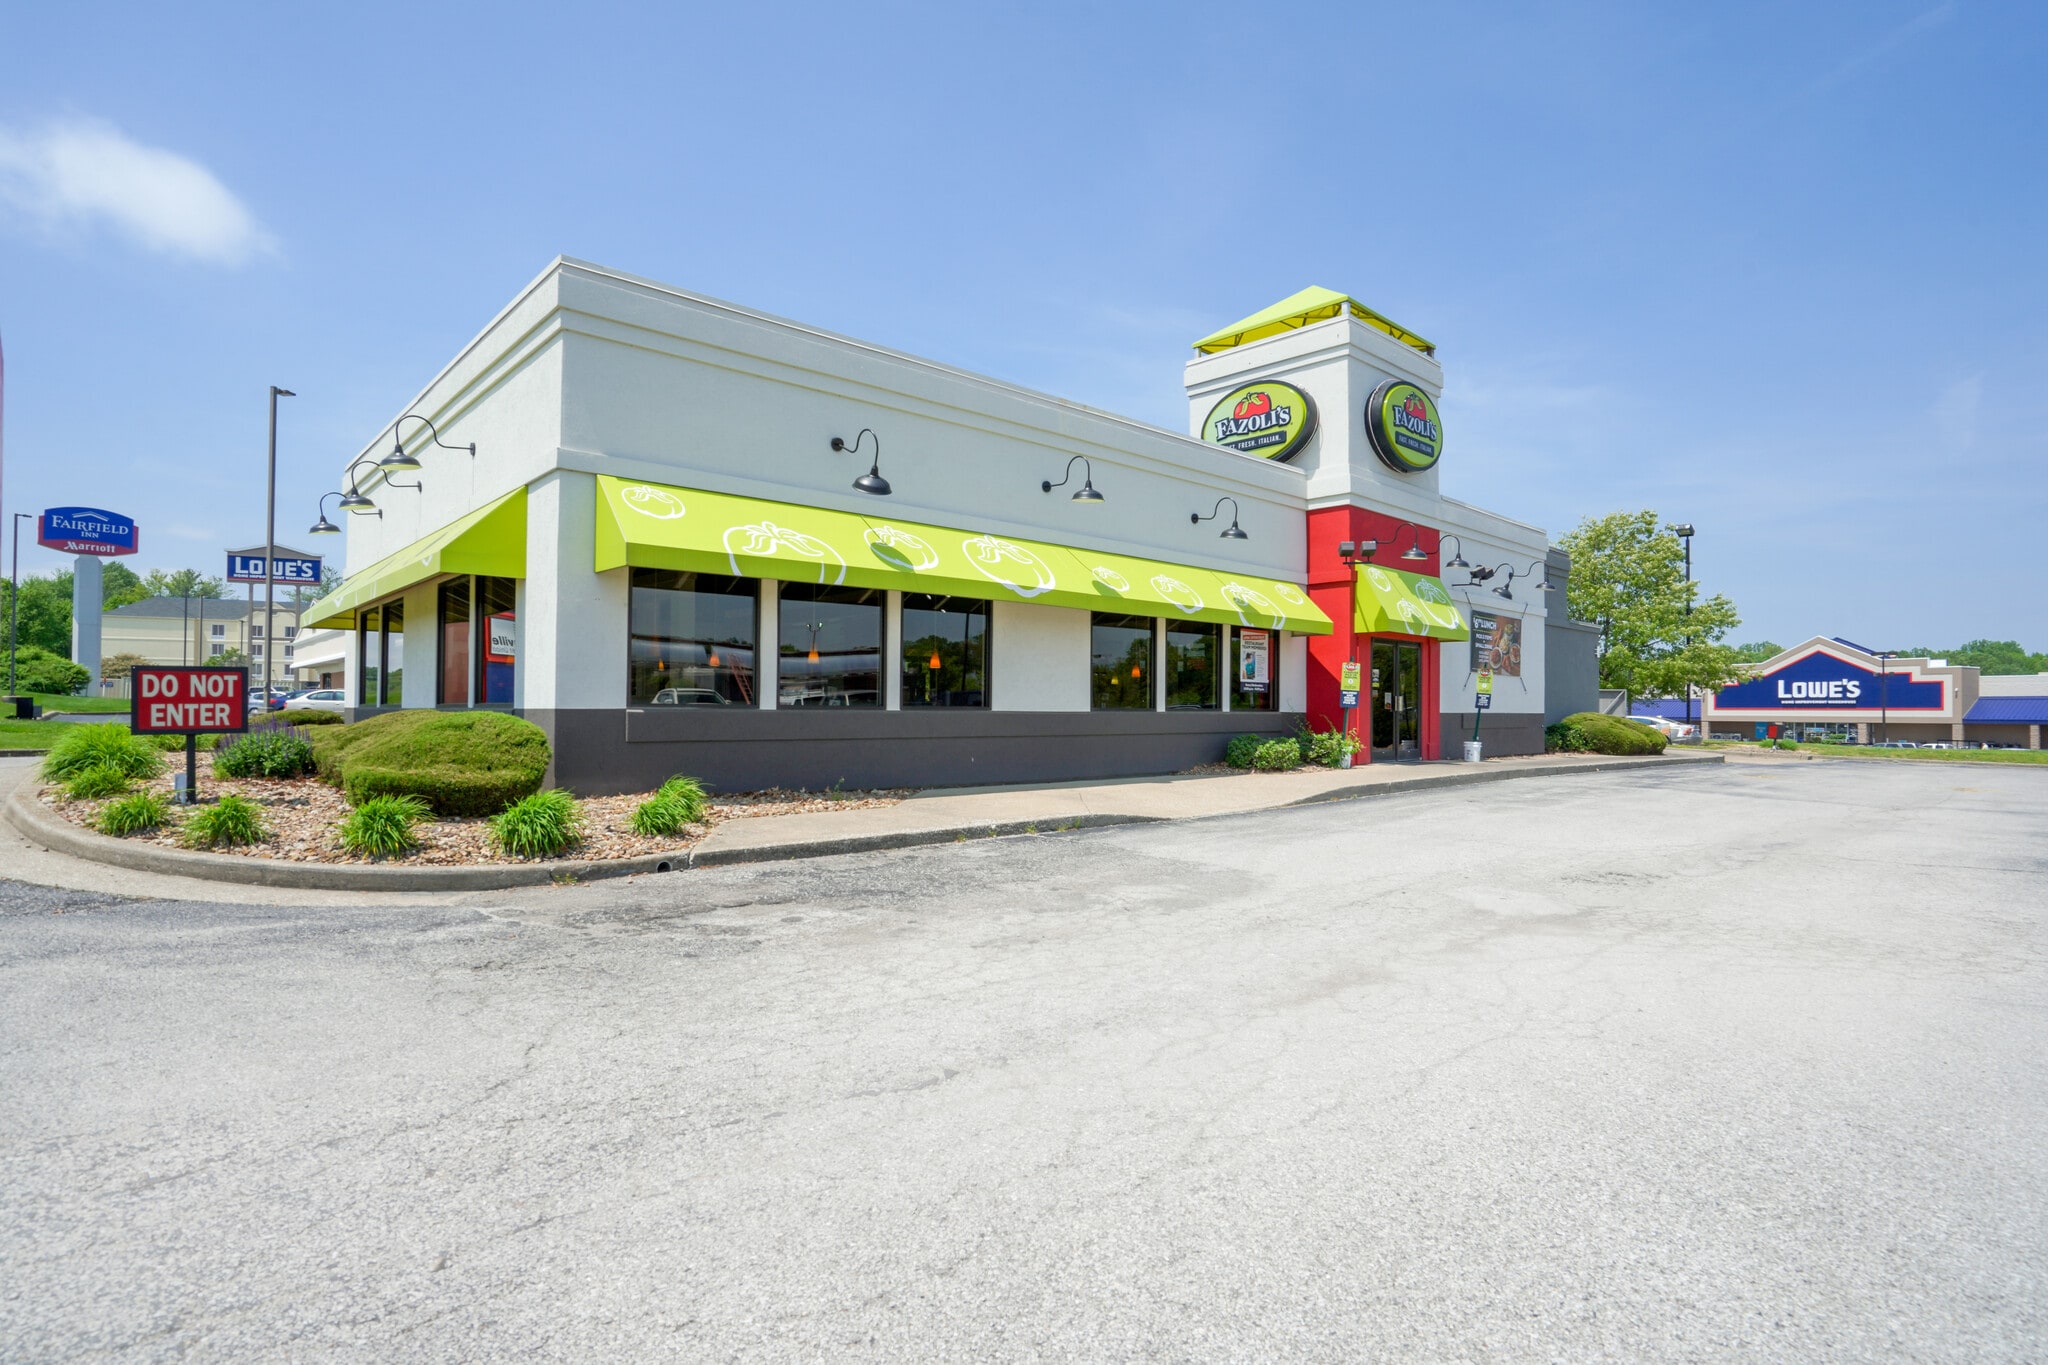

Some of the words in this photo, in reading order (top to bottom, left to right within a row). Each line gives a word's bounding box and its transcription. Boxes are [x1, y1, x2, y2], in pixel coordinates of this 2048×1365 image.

[1215, 406, 1291, 439] FAZOLI'S
[1393, 406, 1437, 440] FAZOLI'S
[51, 514, 129, 535] FAIRFIELD
[64, 541, 116, 553] Marriott
[235, 556, 314, 578] LOWE'S
[142, 674, 179, 698] DO
[189, 674, 238, 698] NOT
[1778, 678, 1861, 698] LOWE'S
[150, 703, 231, 727] ENTER
